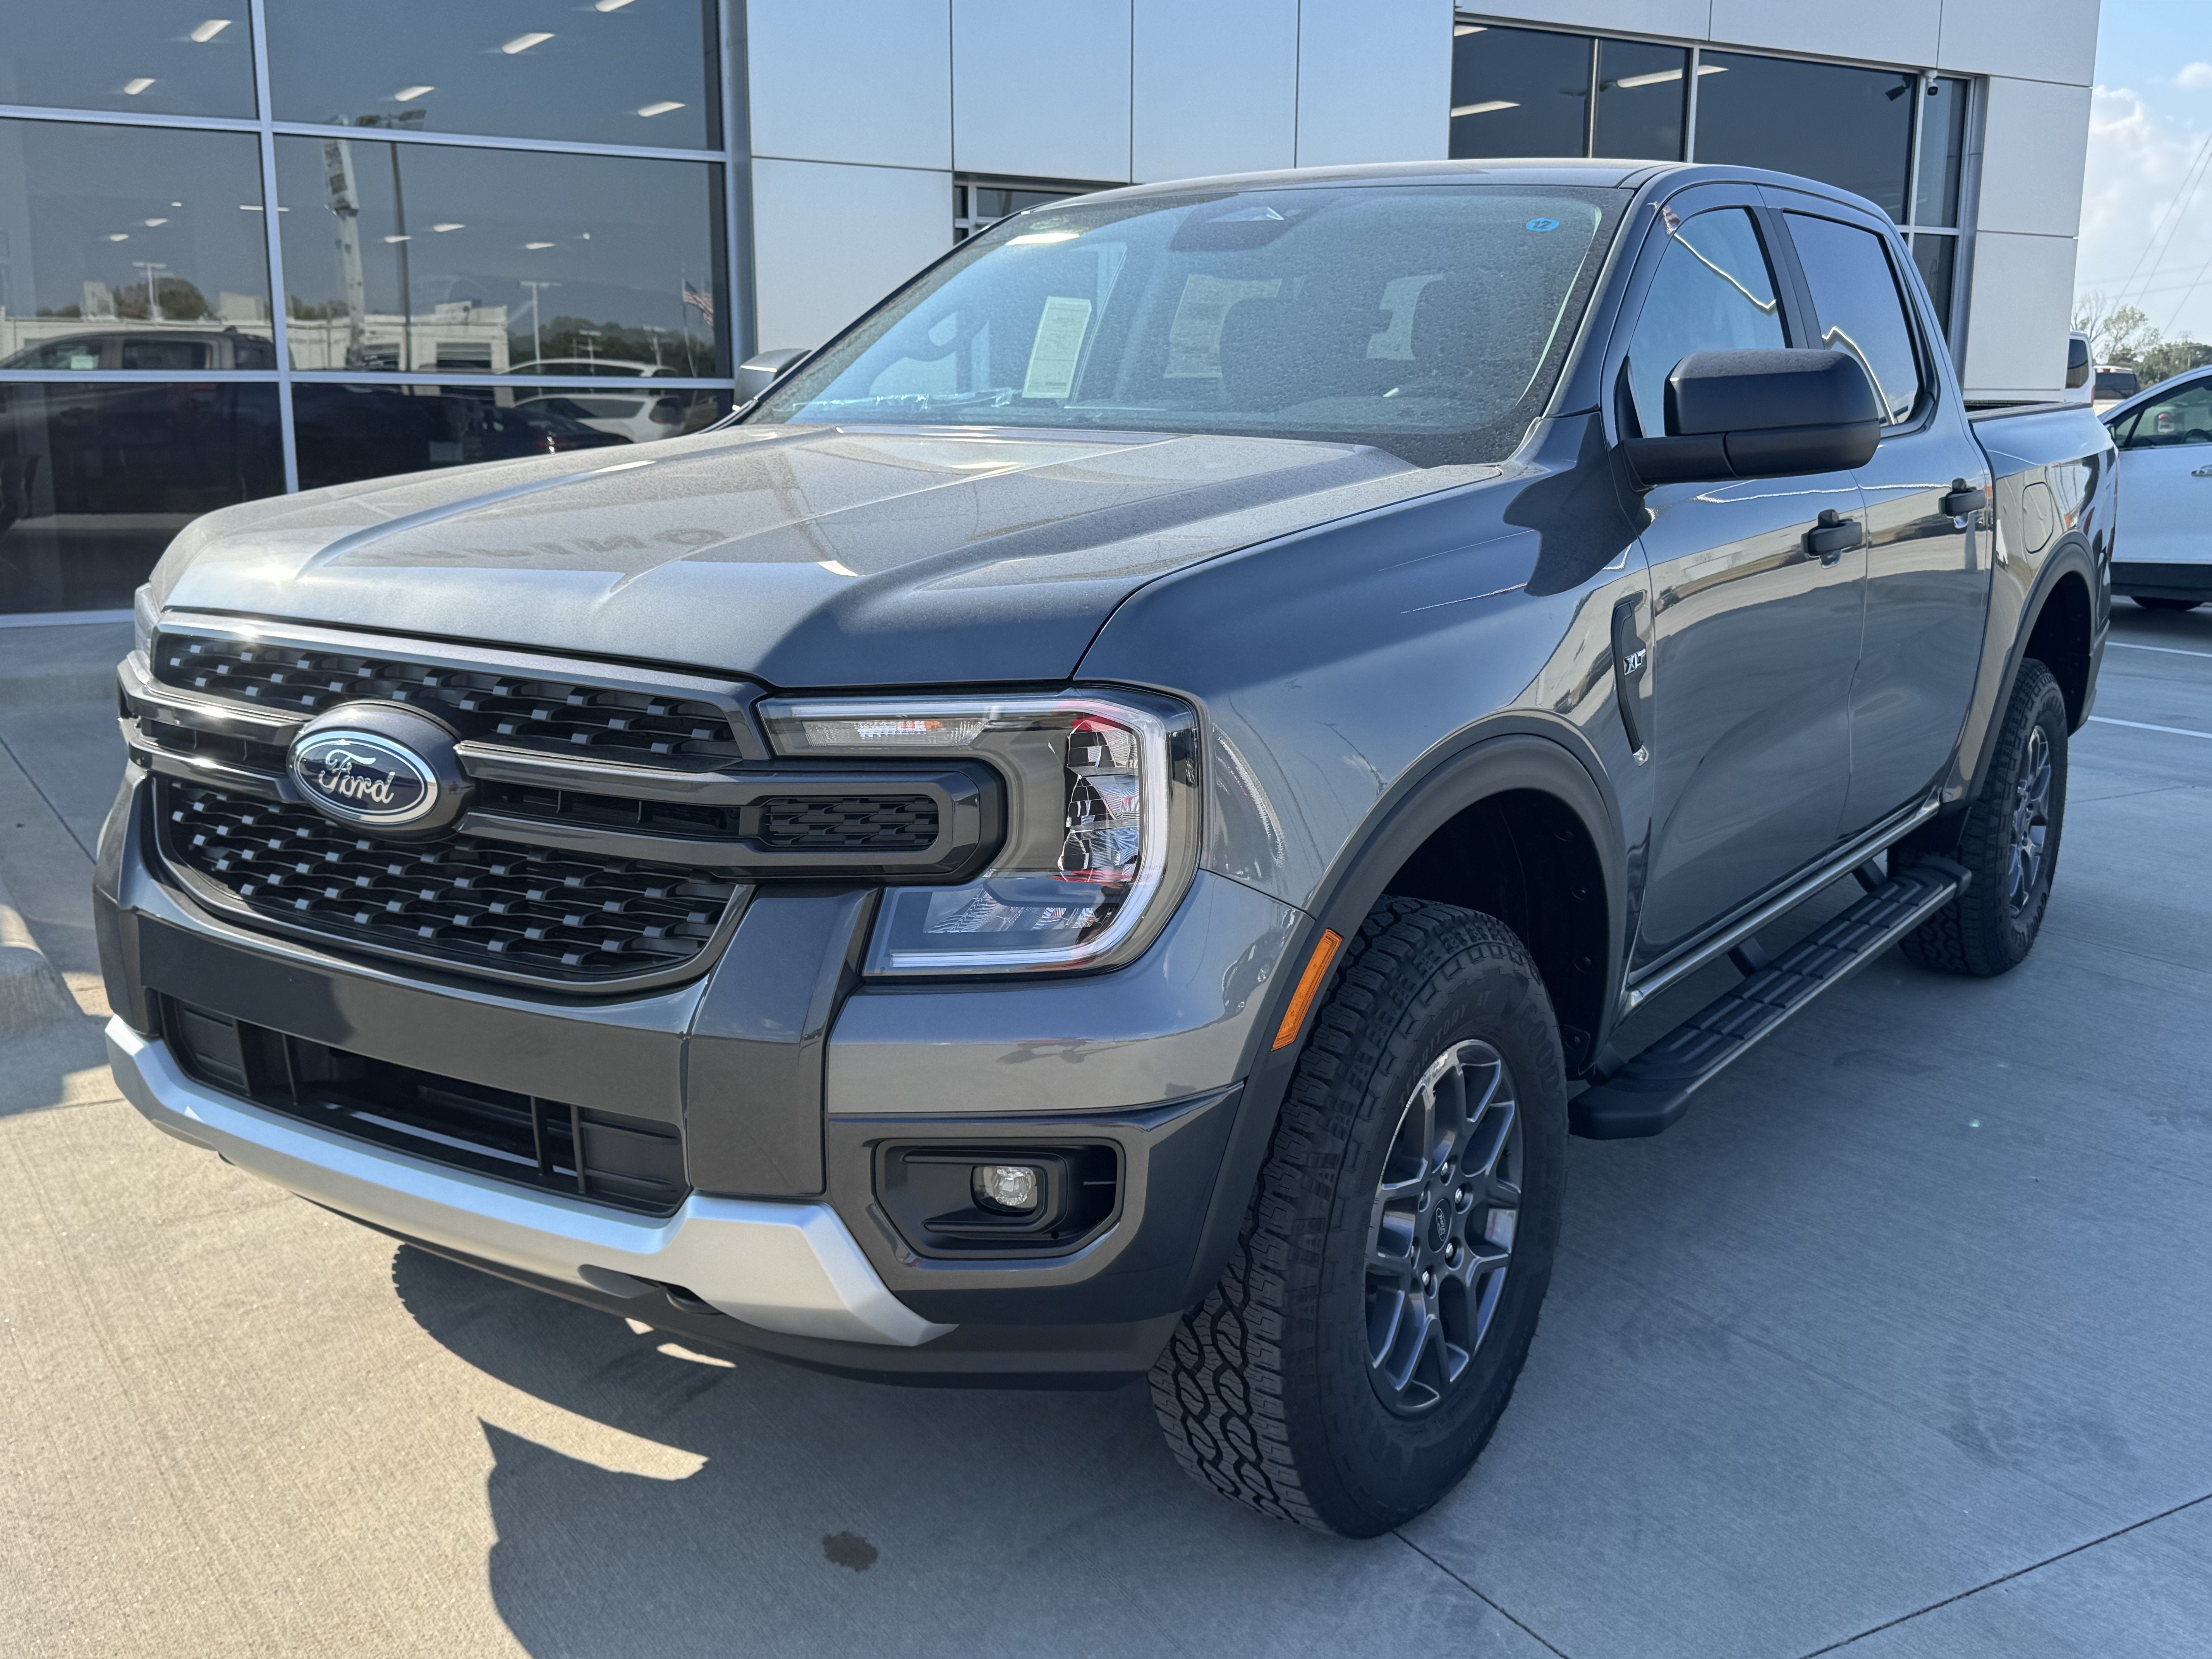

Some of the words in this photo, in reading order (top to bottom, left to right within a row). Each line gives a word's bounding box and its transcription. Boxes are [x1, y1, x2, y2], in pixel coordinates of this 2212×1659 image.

[1532, 220, 1552, 229] 12
[1625, 648, 1646, 674] XLT
[318, 749, 395, 804] Ford
